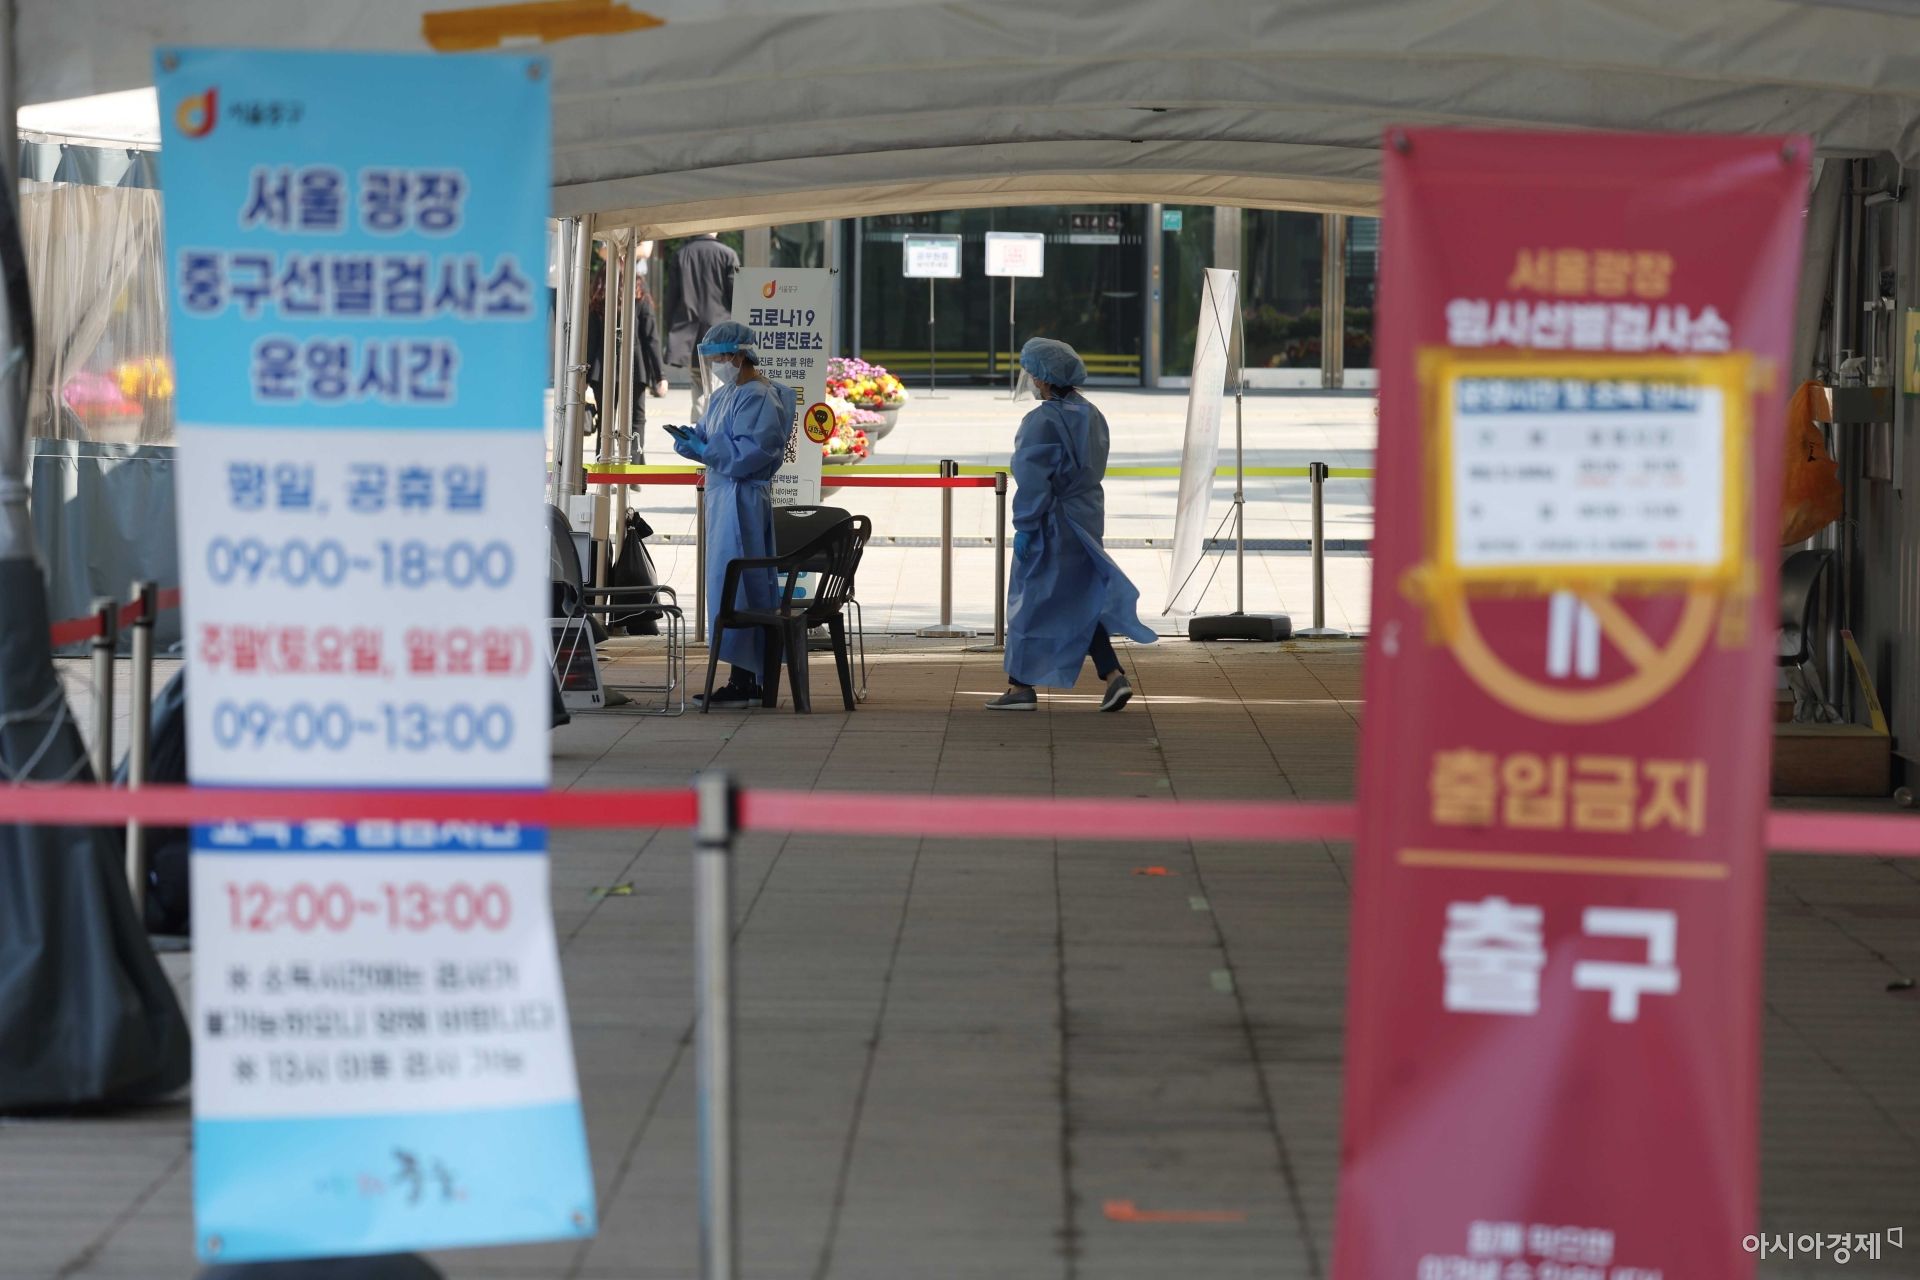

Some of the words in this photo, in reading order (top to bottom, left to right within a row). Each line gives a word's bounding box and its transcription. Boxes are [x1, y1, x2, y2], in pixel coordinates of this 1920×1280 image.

[243, 168, 345, 232] 서울
[360, 169, 468, 234] 광장
[179, 252, 532, 319] 중구선별검사소
[1510, 249, 1672, 297] 서울광장
[748, 308, 815, 327] 코로나19
[753, 331, 823, 350] 시선별진료소
[1446, 299, 1731, 351] 임시선별검사소
[253, 338, 456, 403] 운영시간
[768, 369, 782, 378] 정보
[784, 369, 806, 379] 입력용
[776, 357, 797, 367] 접수를
[799, 357, 814, 367] 위한
[227, 463, 331, 515] 평일,
[347, 463, 488, 514] 공휴일
[207, 536, 514, 589] 09:00~18:00
[404, 626, 533, 678] 일요일)
[212, 702, 514, 752] 09:00~13:00
[1431, 747, 1708, 836] 출입금지
[226, 881, 512, 933] 12:00~13:00
